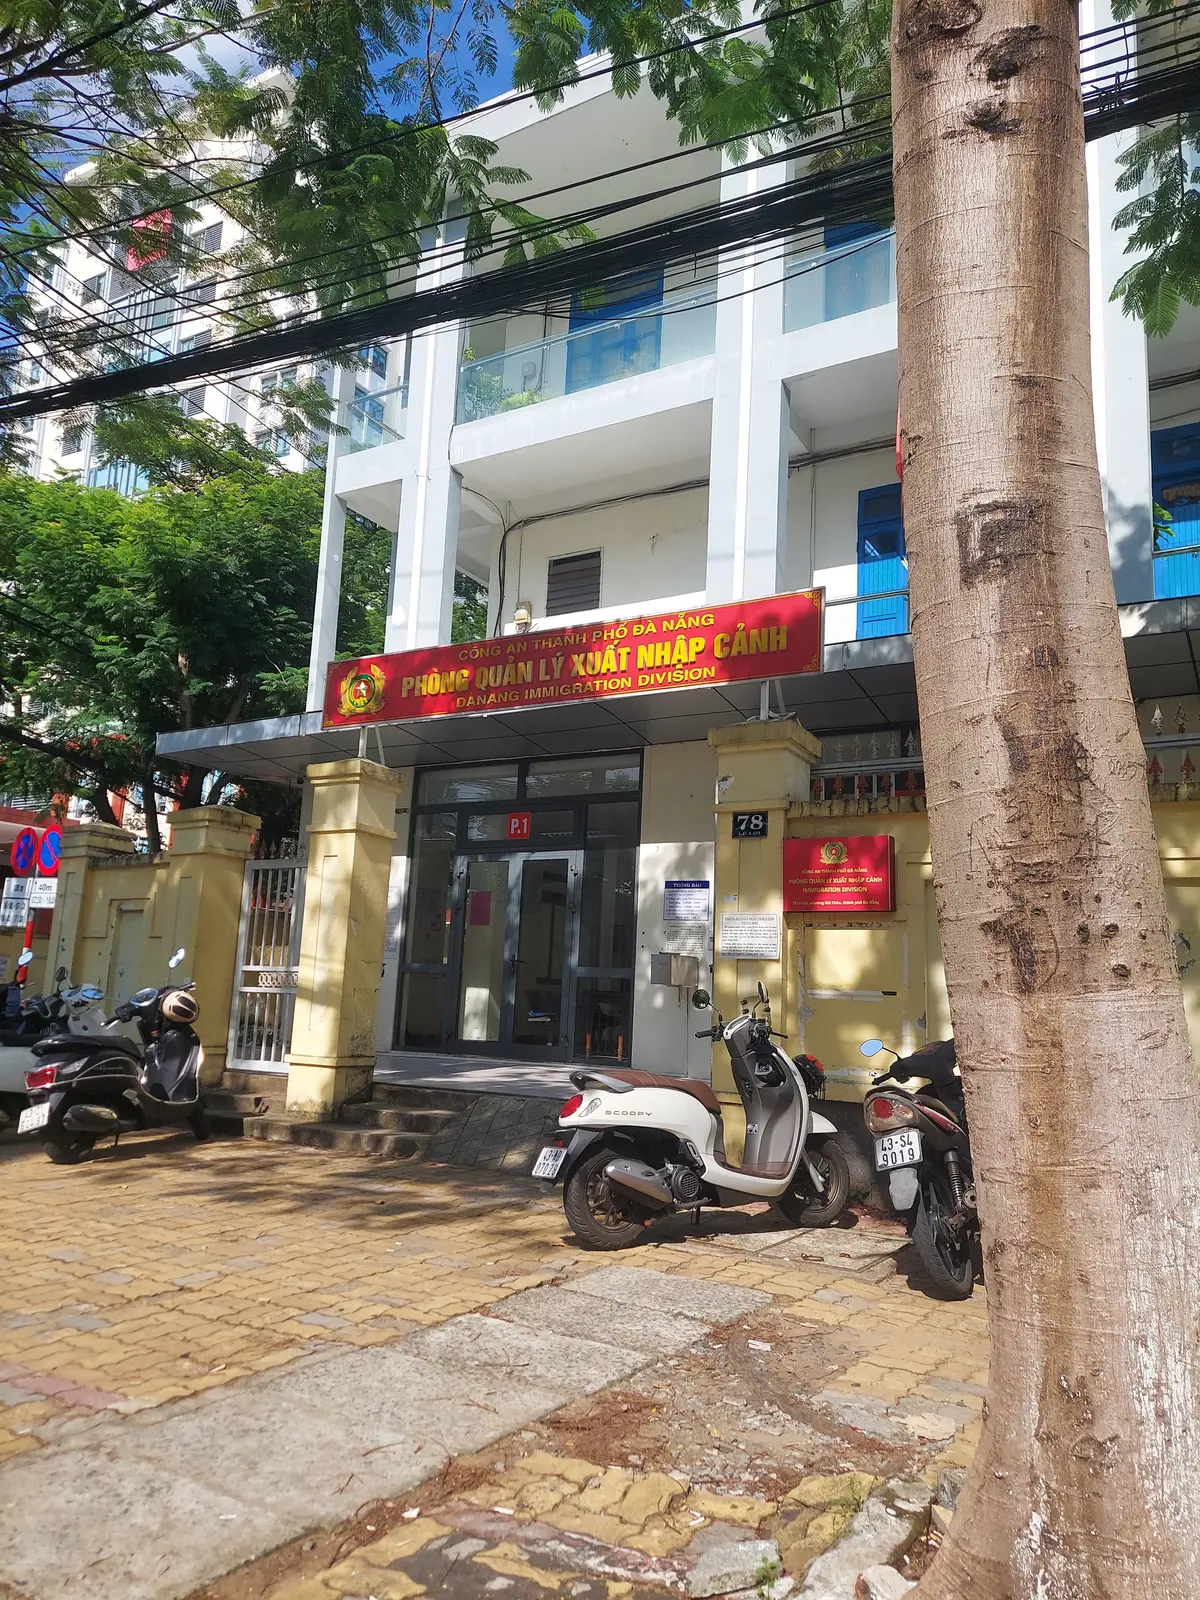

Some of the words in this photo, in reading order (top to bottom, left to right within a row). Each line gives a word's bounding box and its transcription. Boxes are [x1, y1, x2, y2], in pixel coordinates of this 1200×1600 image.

[458, 645, 502, 661] CÔNG
[506, 641, 528, 654] AN
[532, 629, 587, 650] THÀNH
[592, 621, 628, 642] PHỐ
[632, 619, 658, 637] ĐÀ
[662, 612, 715, 632] NẴNG
[401, 667, 470, 698] PHÒNG
[475, 656, 533, 691] QUẢN
[538, 651, 566, 682] LÝ
[570, 640, 631, 677] XUẤT
[636, 634, 706, 671] NHẬP
[713, 622, 788, 658] CẢNH
[456, 690, 520, 708] DANANG
[524, 675, 632, 700] IMMIGRATION
[637, 666, 716, 687] DIVISION
[510, 817, 528, 834] P.1
[737, 814, 764, 831] 78
[833, 875, 847, 883] XUẤT
[865, 875, 883, 883] CẢNH
[881, 1133, 913, 1152] 43-S4
[882, 1147, 915, 1167] 9019
